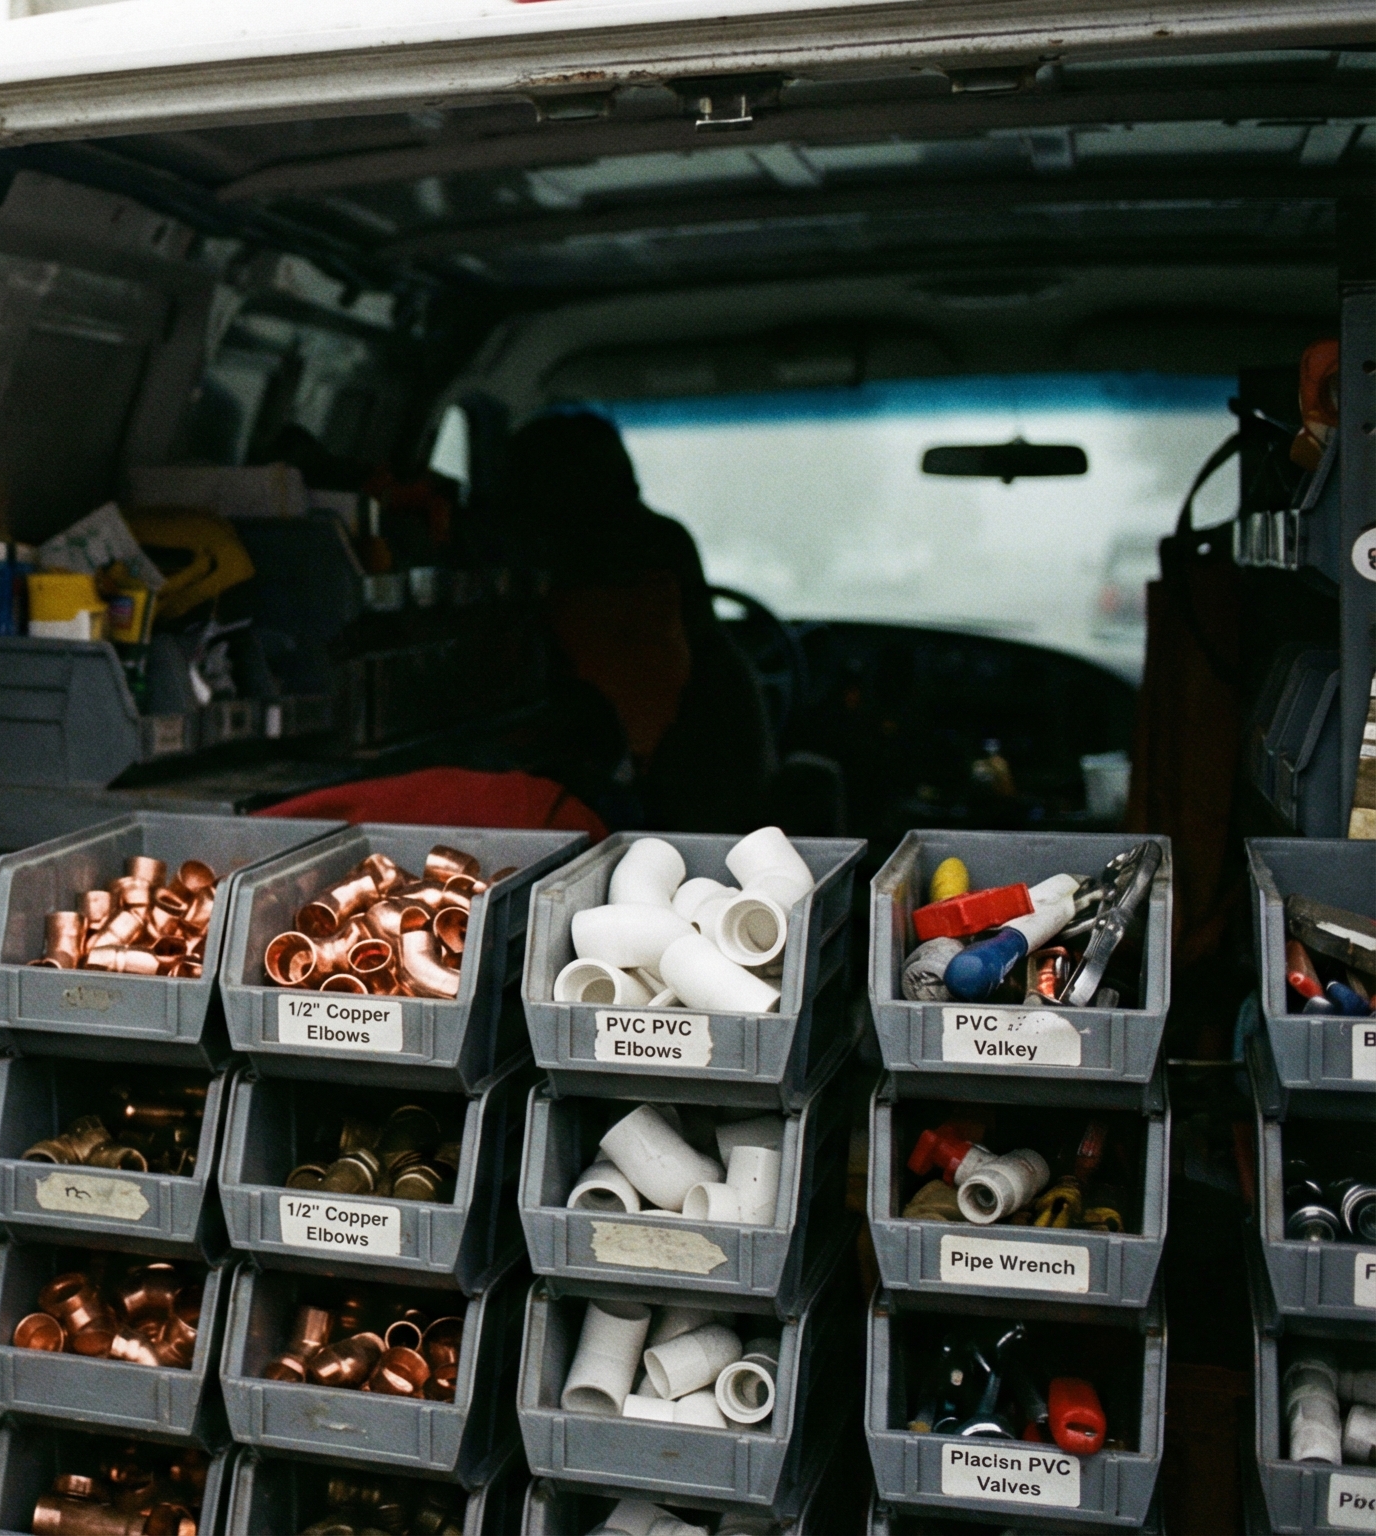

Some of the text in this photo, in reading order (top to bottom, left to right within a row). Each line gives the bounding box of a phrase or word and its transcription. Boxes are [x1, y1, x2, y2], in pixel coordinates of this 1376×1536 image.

[288, 1002, 390, 1024] 1/2" Copper
[956, 1015, 998, 1031] PVC
[307, 1025, 370, 1043] Elbows
[607, 1017, 692, 1036] PVC PVC
[614, 1040, 682, 1059] Elbows
[974, 1040, 1038, 1061] Valkey
[287, 1202, 388, 1228] 1/2" Copper
[307, 1226, 369, 1247] Elbows
[951, 1251, 1075, 1275] Pipe Wrench
[951, 1450, 1071, 1476] Placisn PVC
[977, 1475, 1041, 1496] Valves
